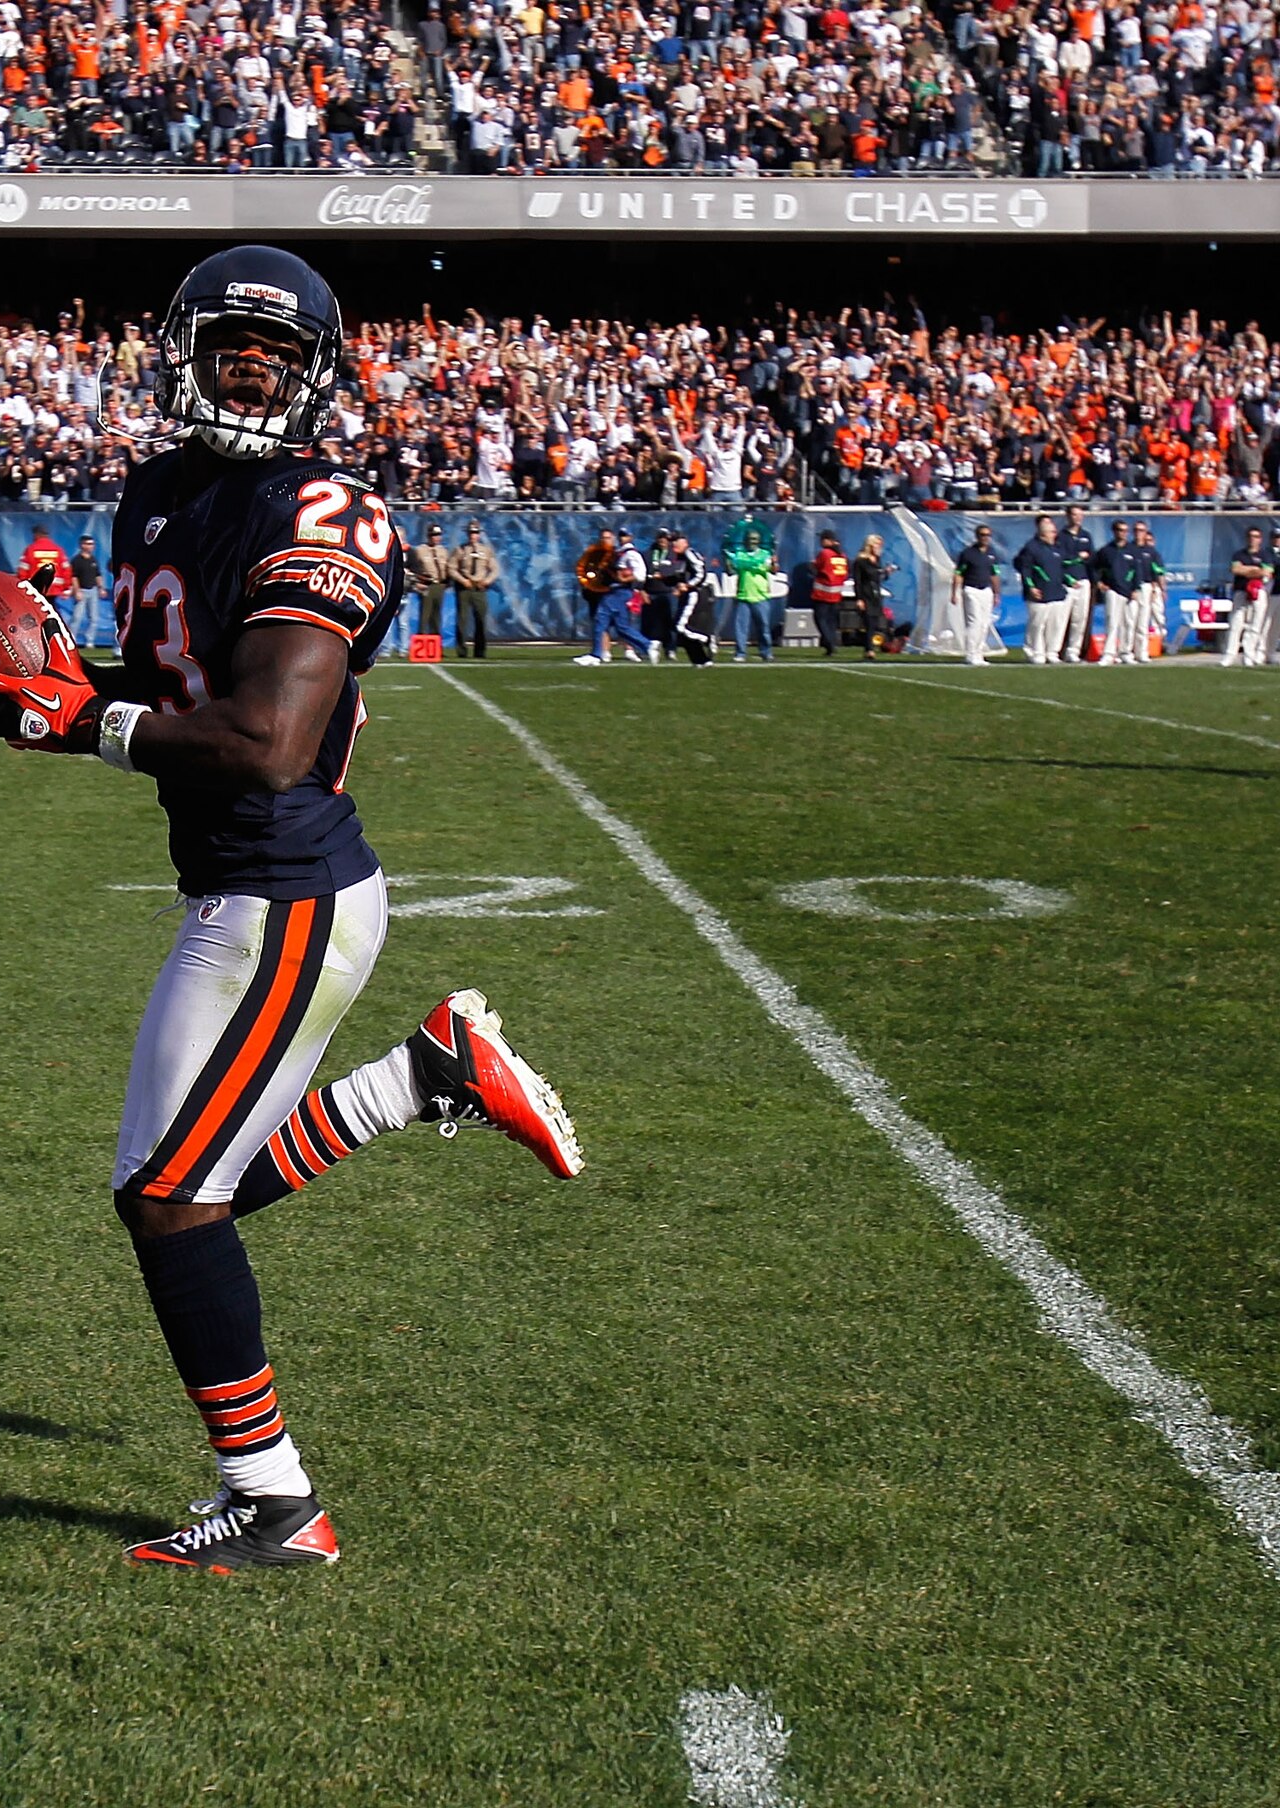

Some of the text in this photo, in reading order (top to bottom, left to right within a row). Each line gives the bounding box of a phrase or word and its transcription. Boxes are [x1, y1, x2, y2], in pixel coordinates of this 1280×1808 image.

[38, 196, 192, 212] MOTOROLA
[580, 192, 798, 220] UNITED
[845, 191, 999, 224] CHASE
[293, 478, 395, 564] 23
[309, 563, 355, 602] GSH
[414, 639, 436, 658] 20
